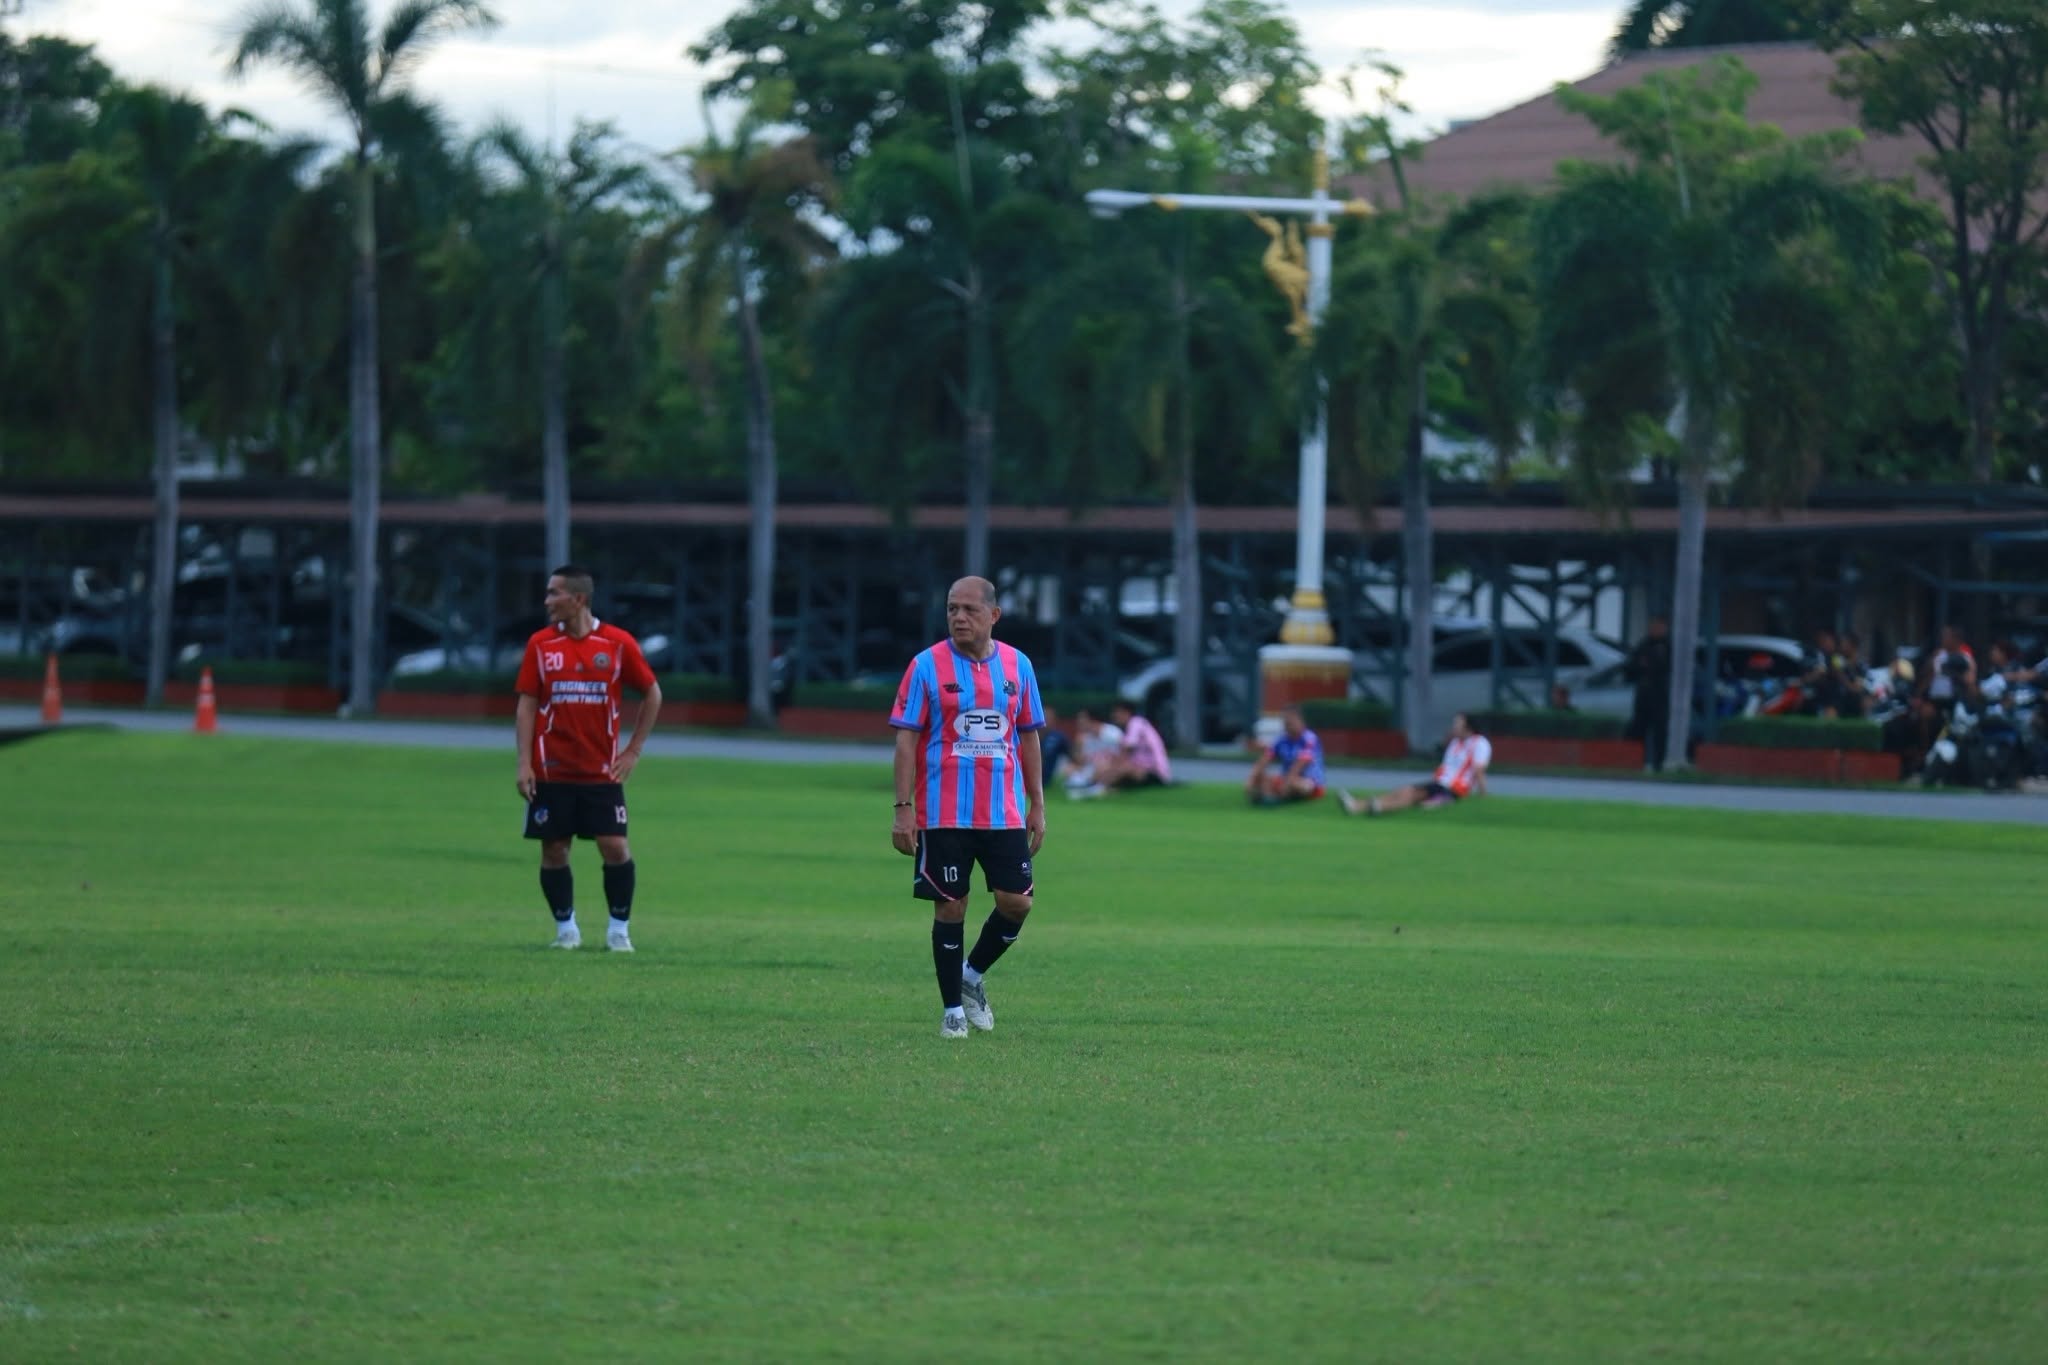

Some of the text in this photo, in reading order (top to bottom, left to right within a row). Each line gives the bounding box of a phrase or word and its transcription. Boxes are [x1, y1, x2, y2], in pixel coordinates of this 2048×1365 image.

[545, 652, 563, 671] 20
[551, 681, 607, 693] ENGINEER
[964, 715, 1000, 732] PS
[943, 866, 958, 882] 10
